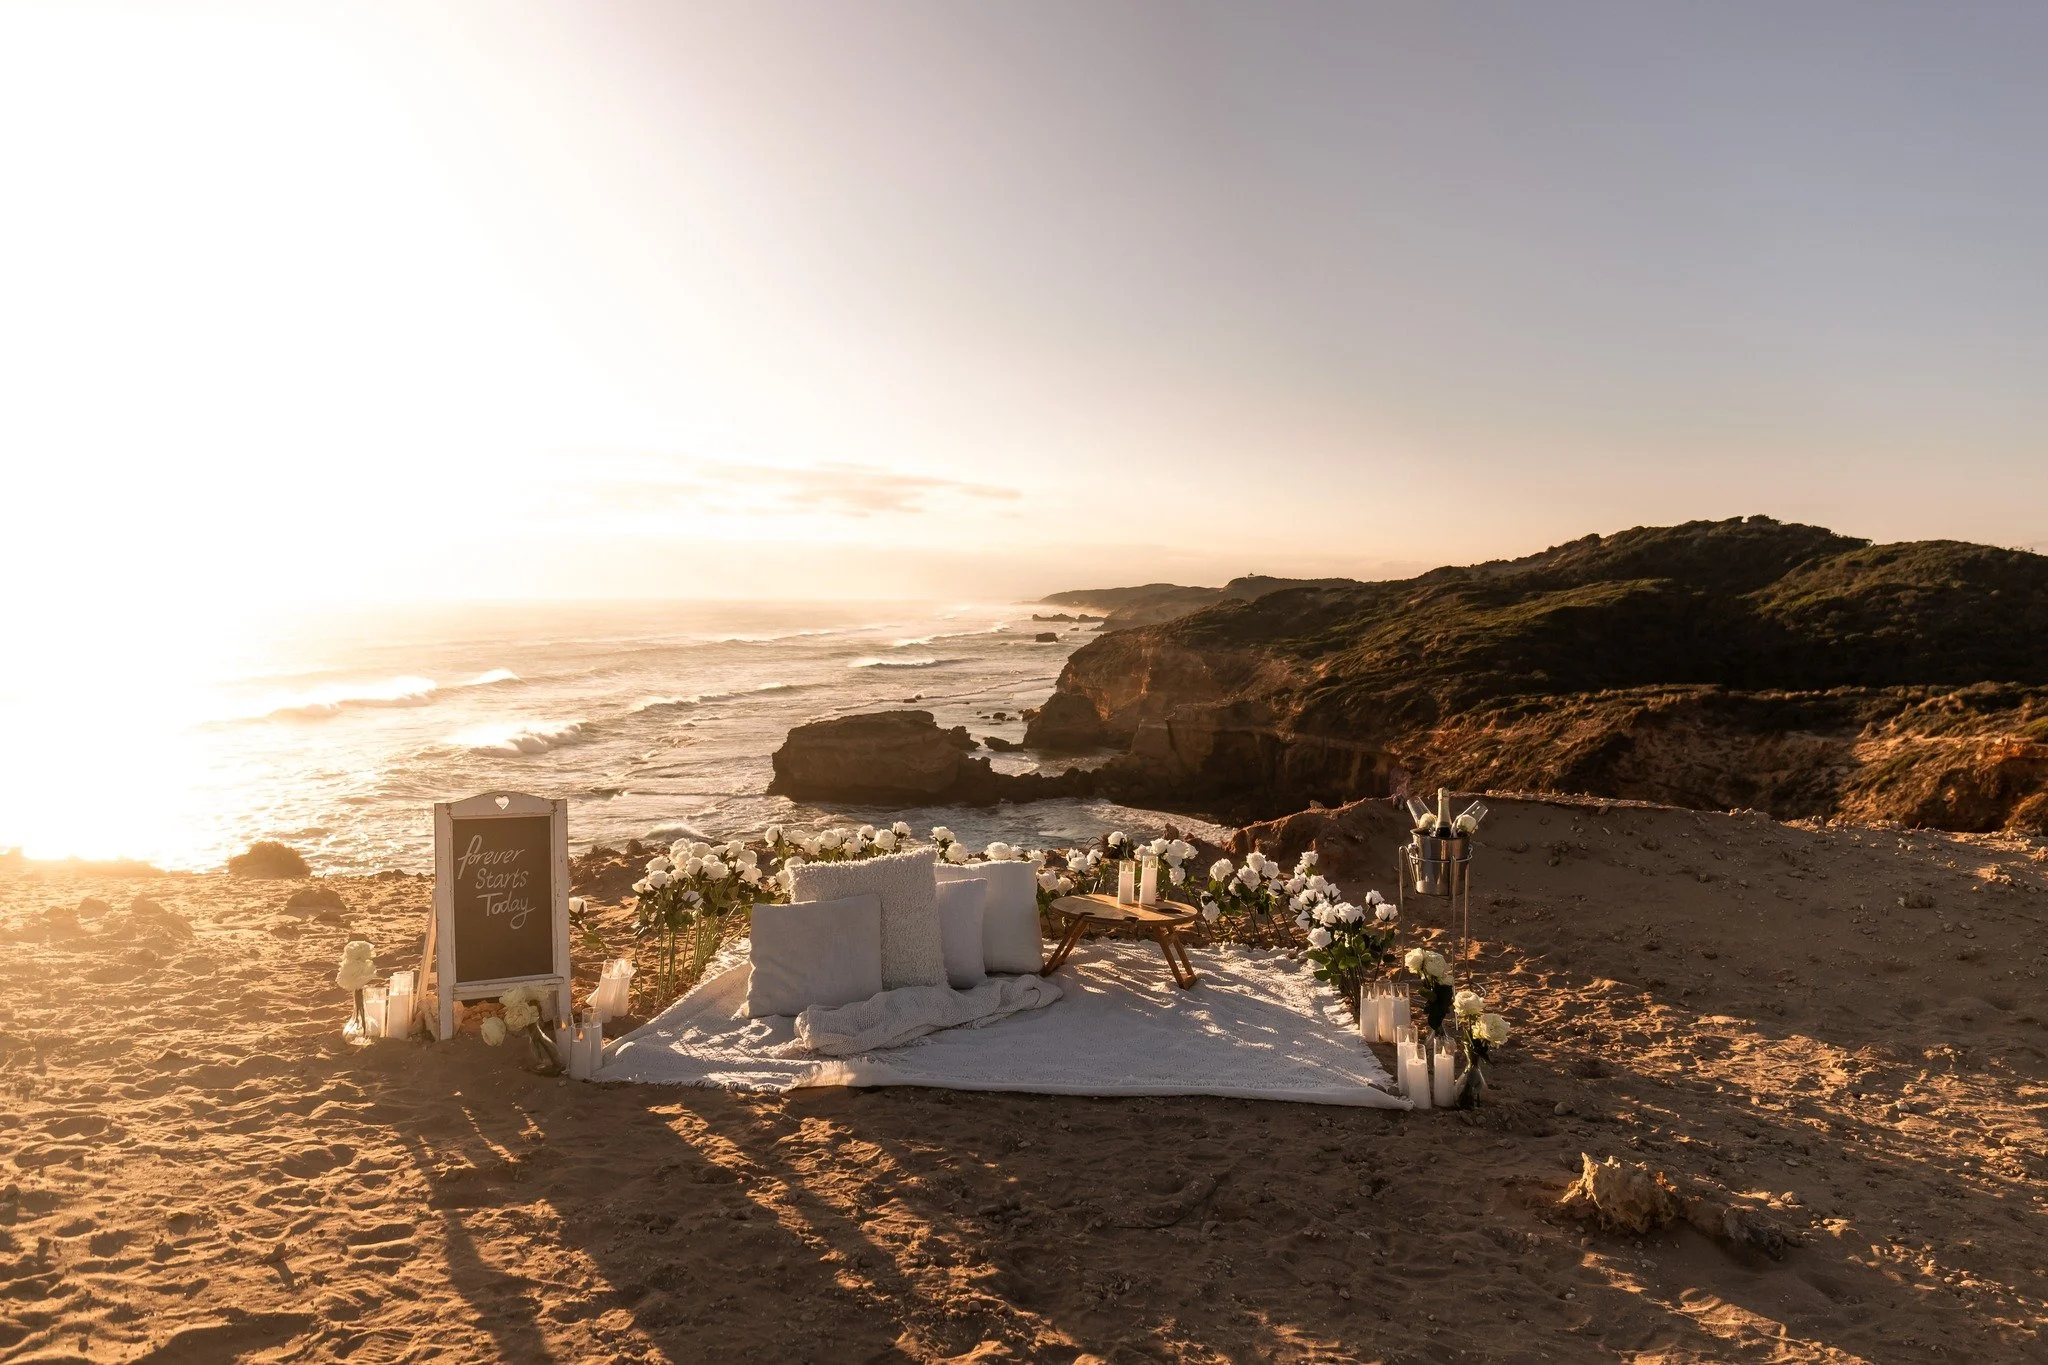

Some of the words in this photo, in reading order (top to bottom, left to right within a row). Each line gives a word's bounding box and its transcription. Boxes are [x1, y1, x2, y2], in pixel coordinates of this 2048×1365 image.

[457, 834, 525, 879] forever
[475, 867, 530, 890] Starts
[476, 891, 537, 930] Today
